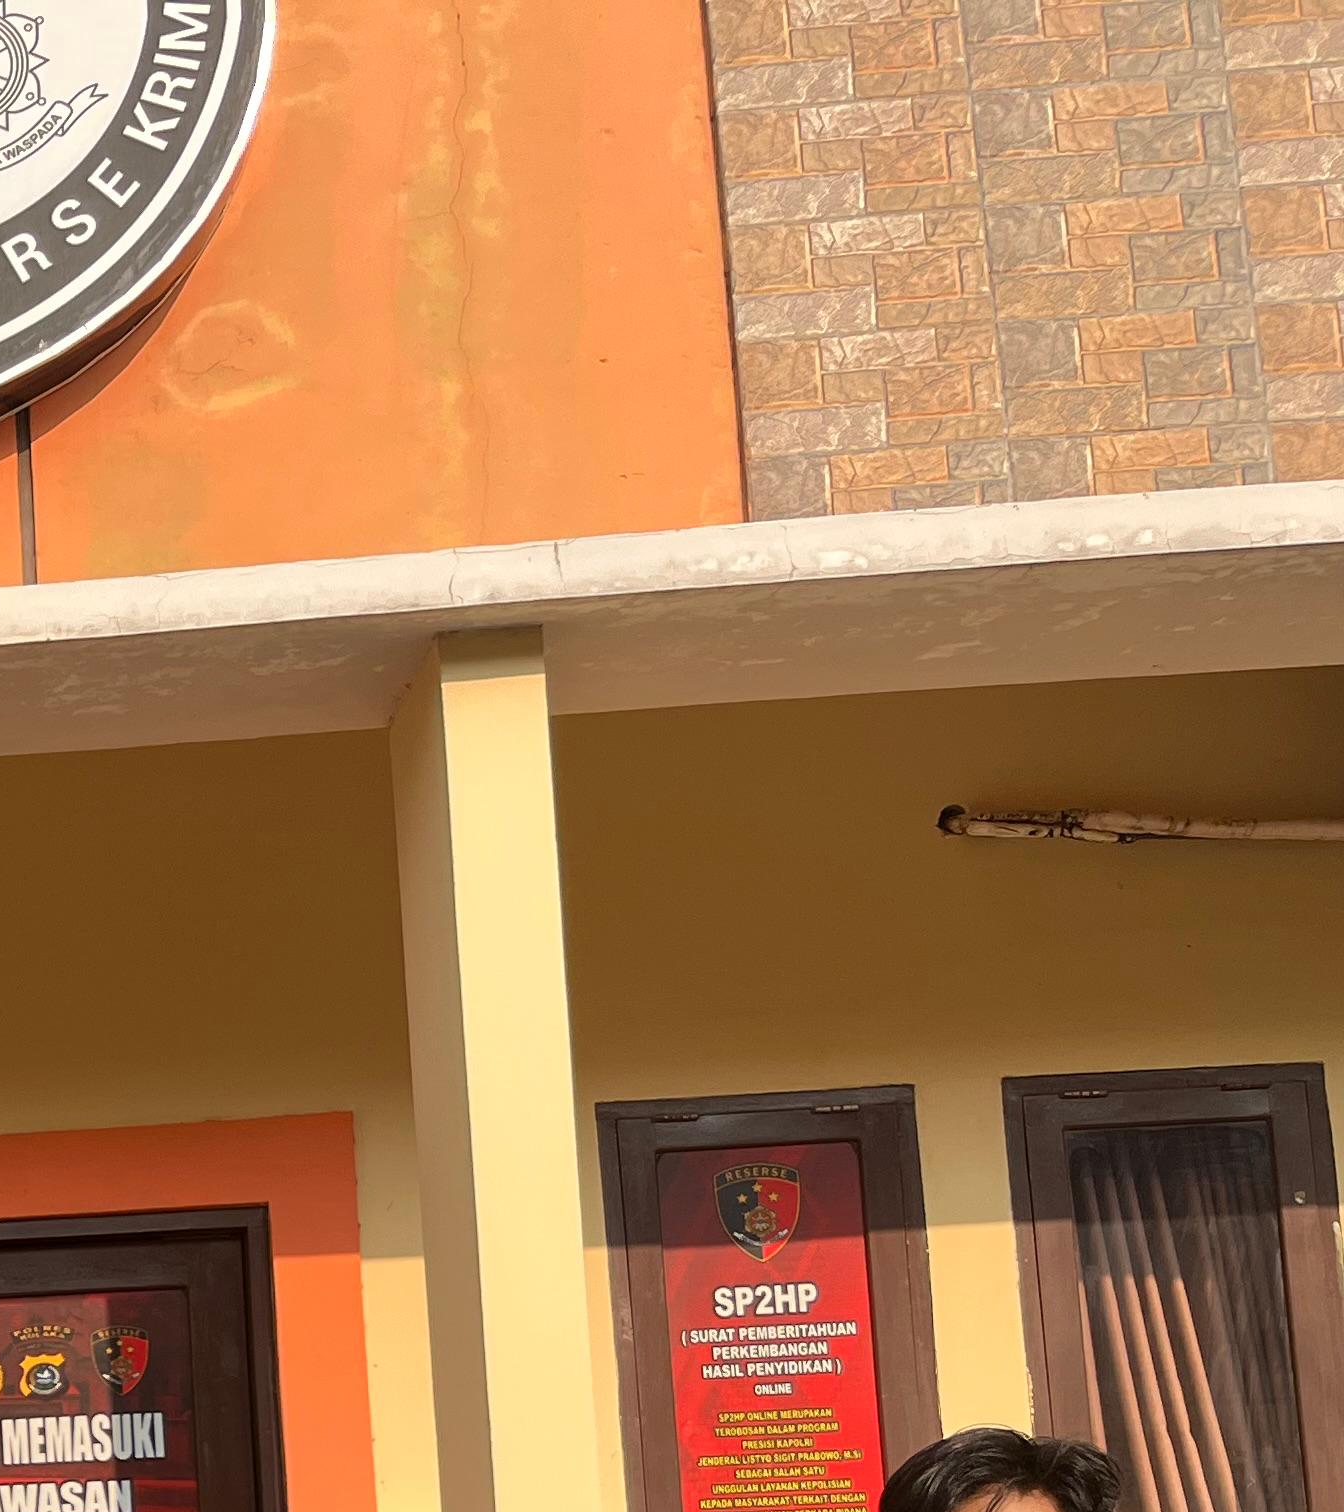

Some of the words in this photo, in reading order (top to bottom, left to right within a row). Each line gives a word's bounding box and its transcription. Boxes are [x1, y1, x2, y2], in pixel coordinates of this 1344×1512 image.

[122, 2, 211, 151] KRIM
[4, 113, 63, 160] WASPADA
[725, 1167, 788, 1182] RESERSE
[714, 1283, 817, 1317] SP2HP
[690, 1329, 735, 1344] SURAT
[739, 1322, 857, 1341] PEMBERITAHUAN
[712, 1342, 828, 1360] PERKEMBANGAN
[702, 1363, 744, 1379] HASIL
[747, 1359, 832, 1377] PENYIDIKAN
[754, 1383, 792, 1395] ONLINE
[718, 1413, 746, 1422] SP2HP
[747, 1411, 778, 1421] ONLINE
[780, 1408, 832, 1419] MERUPAKAN
[767, 1425, 796, 1434] DALAM
[798, 1422, 839, 1432] PROGRAM
[1, 1412, 165, 1466] MEMASUKI
[742, 1440, 775, 1449] PRESISI
[777, 1438, 813, 1448] KAPOLRI
[774, 1453, 796, 1462] SIGIT
[803, 1466, 825, 1475] SATU
[801, 1480, 851, 1490] KEPOLISIAN
[700, 1499, 732, 1509] KEPADA
[735, 1497, 790, 1508] MASYARAKAT
[793, 1494, 828, 1505] TERKAIT
[831, 1492, 866, 1503] DENGAN
